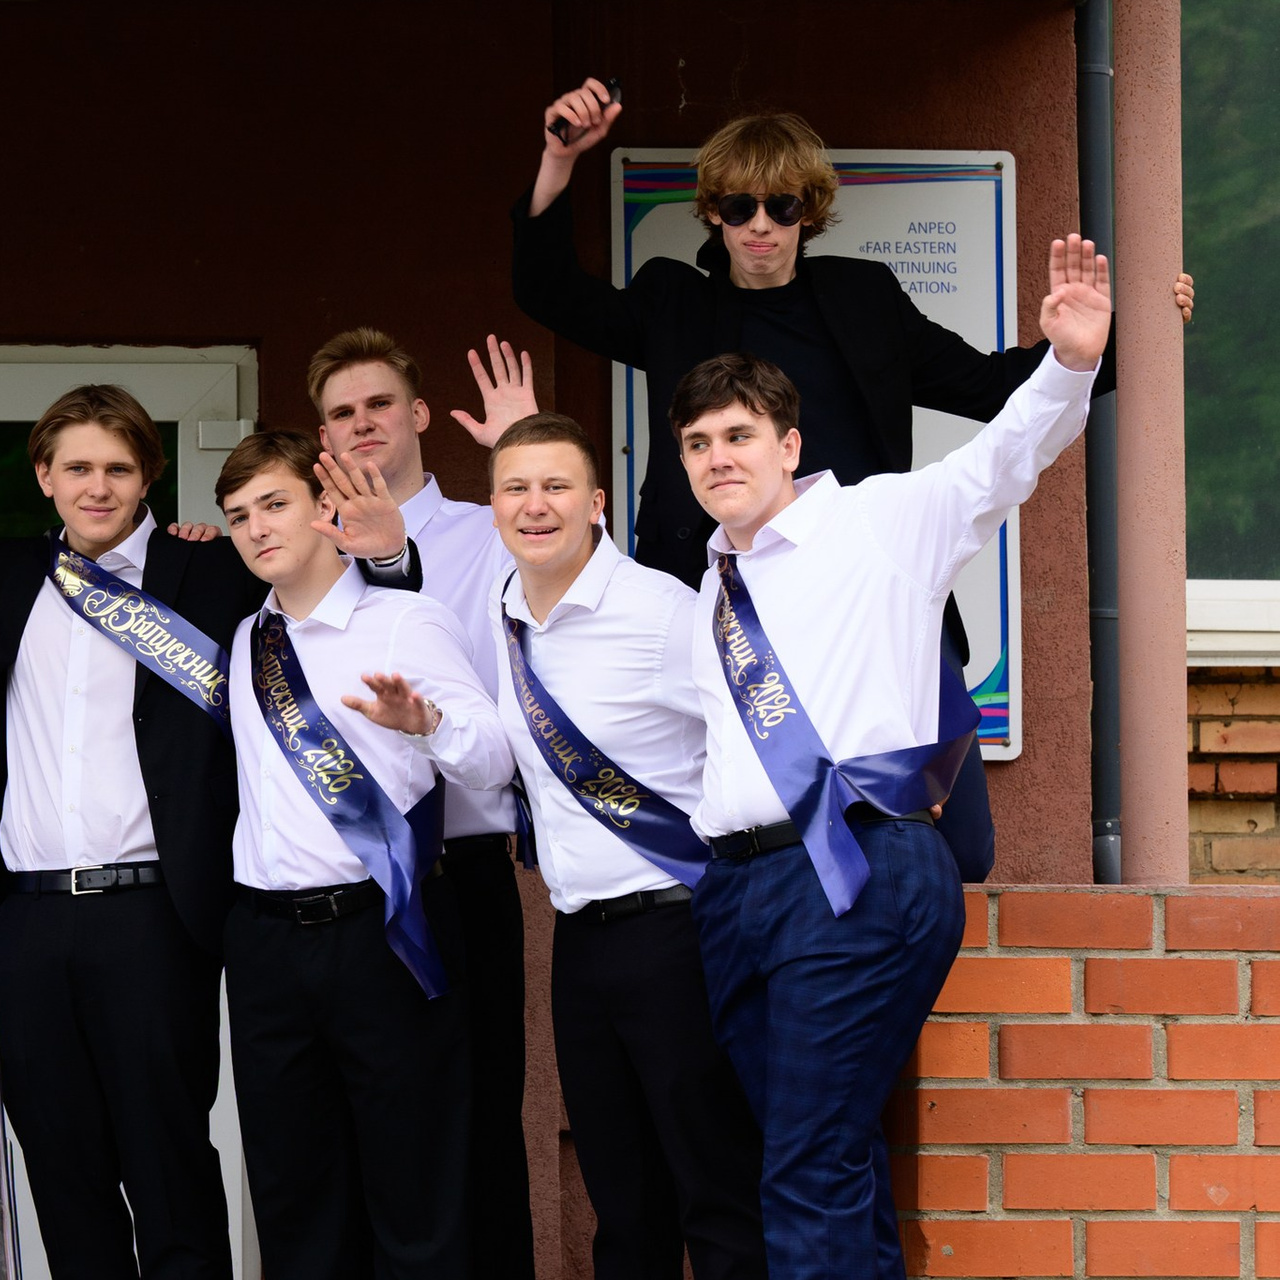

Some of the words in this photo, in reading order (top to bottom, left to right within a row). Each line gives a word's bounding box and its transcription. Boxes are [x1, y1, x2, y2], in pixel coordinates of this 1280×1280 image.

[858, 241, 891, 254] «FAR
[895, 241, 956, 254] EASTERN
[907, 221, 956, 234] ANPEO
[887, 261, 957, 274] NTINUING
[81, 581, 228, 707] Выпускник
[747, 671, 797, 728] 2026
[303, 736, 363, 795] 2026
[582, 767, 650, 817] 2026
